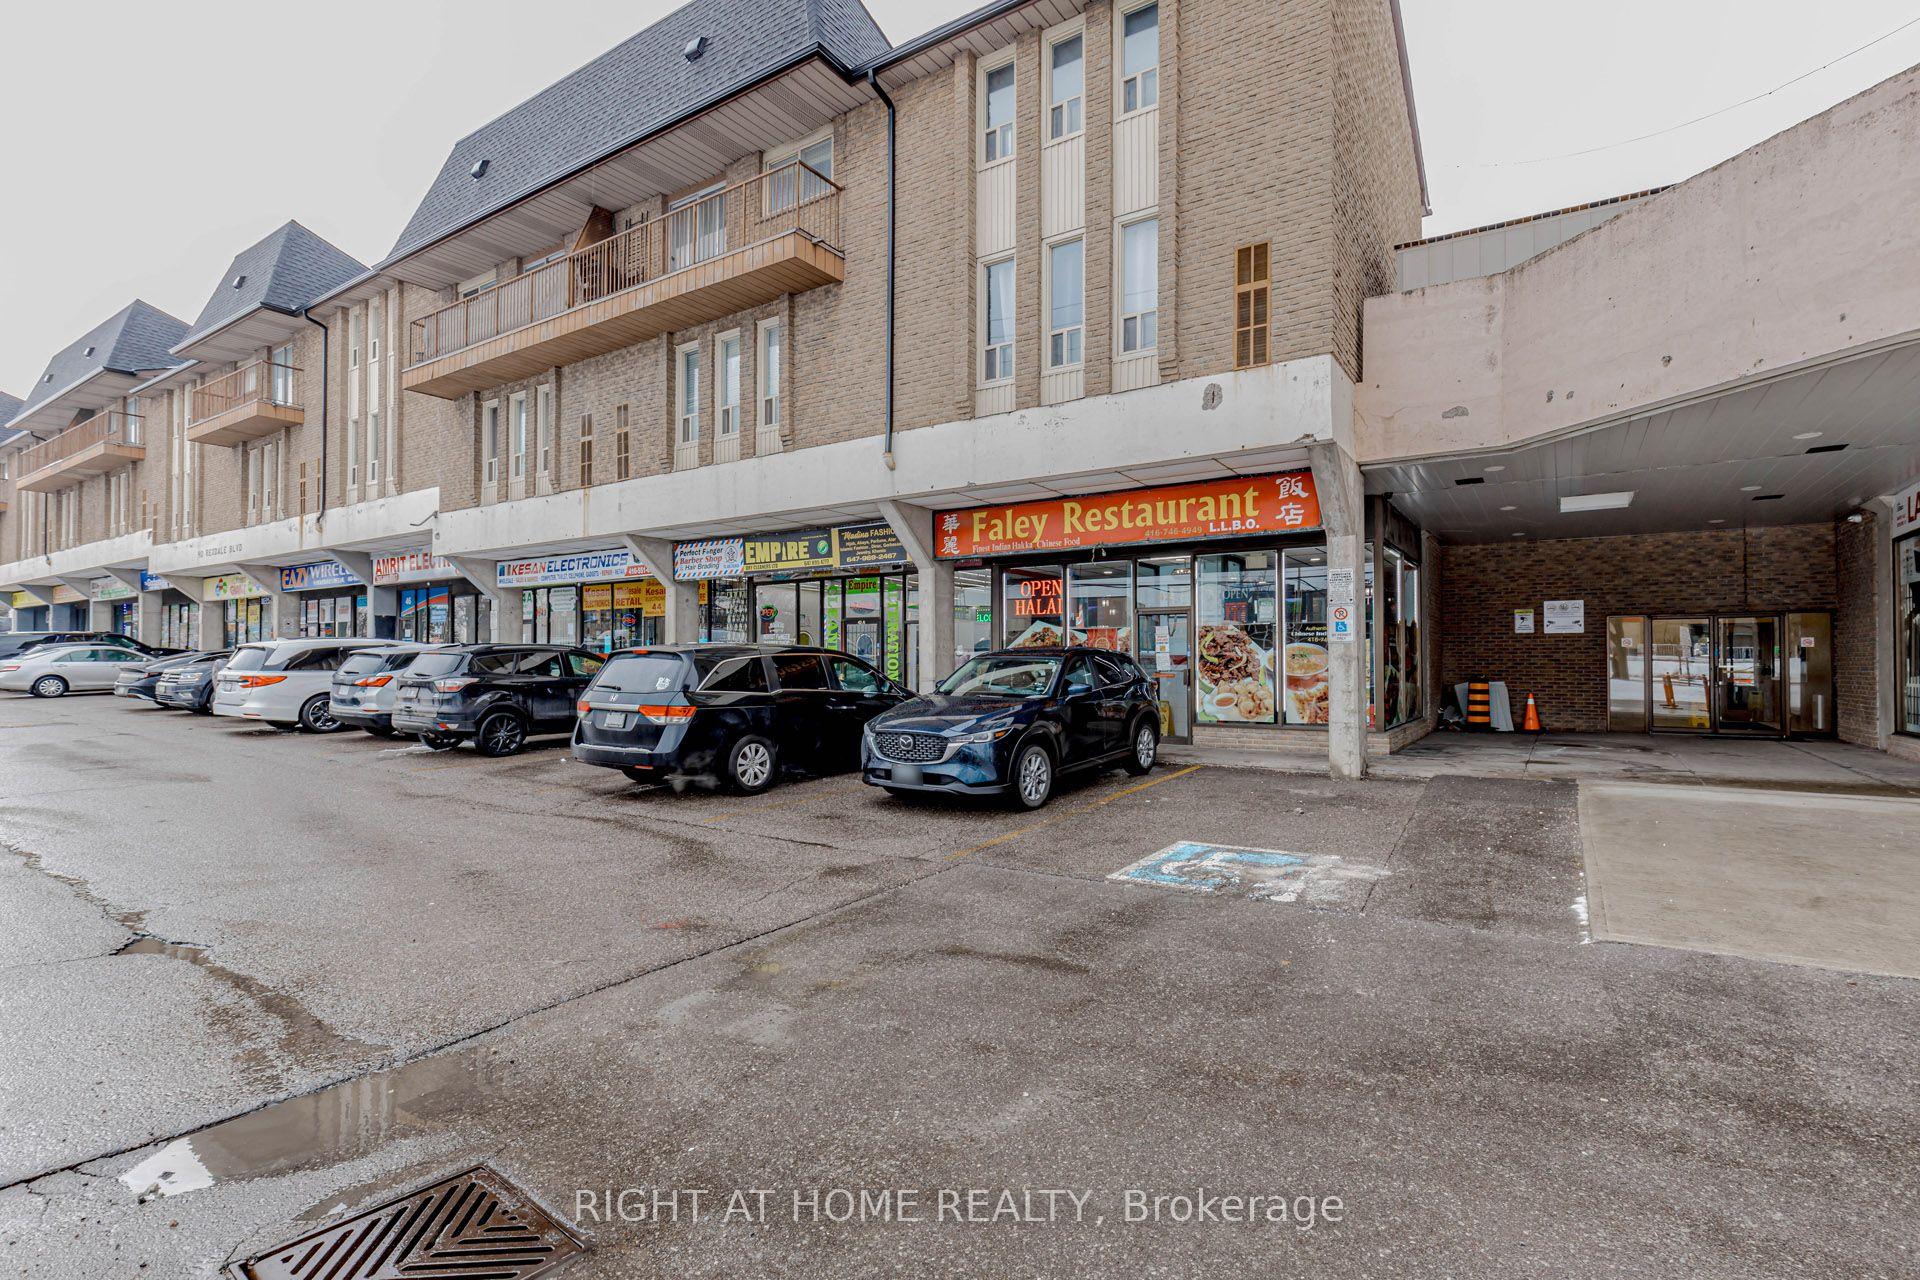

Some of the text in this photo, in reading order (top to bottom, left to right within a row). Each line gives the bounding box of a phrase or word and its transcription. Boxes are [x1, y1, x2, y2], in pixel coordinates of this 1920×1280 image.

[972, 486, 1262, 545] Faley Restaurant
[1209, 518, 1260, 533] L.L.B.O.
[229, 543, 243, 553] BLVD
[1037, 539, 1062, 548] Chinese
[1064, 537, 1080, 546] Food
[680, 549, 701, 557] Perfect
[680, 555, 723, 564] Barber Shop
[745, 541, 810, 564] EMPIRE
[376, 555, 407, 576] AMRIT
[511, 552, 629, 576] KESAN ELECTRONICS
[281, 567, 309, 589] EAZY
[848, 579, 877, 592] Empire
[1020, 579, 1063, 597] OPEN
[615, 597, 642, 607] RETAIL
